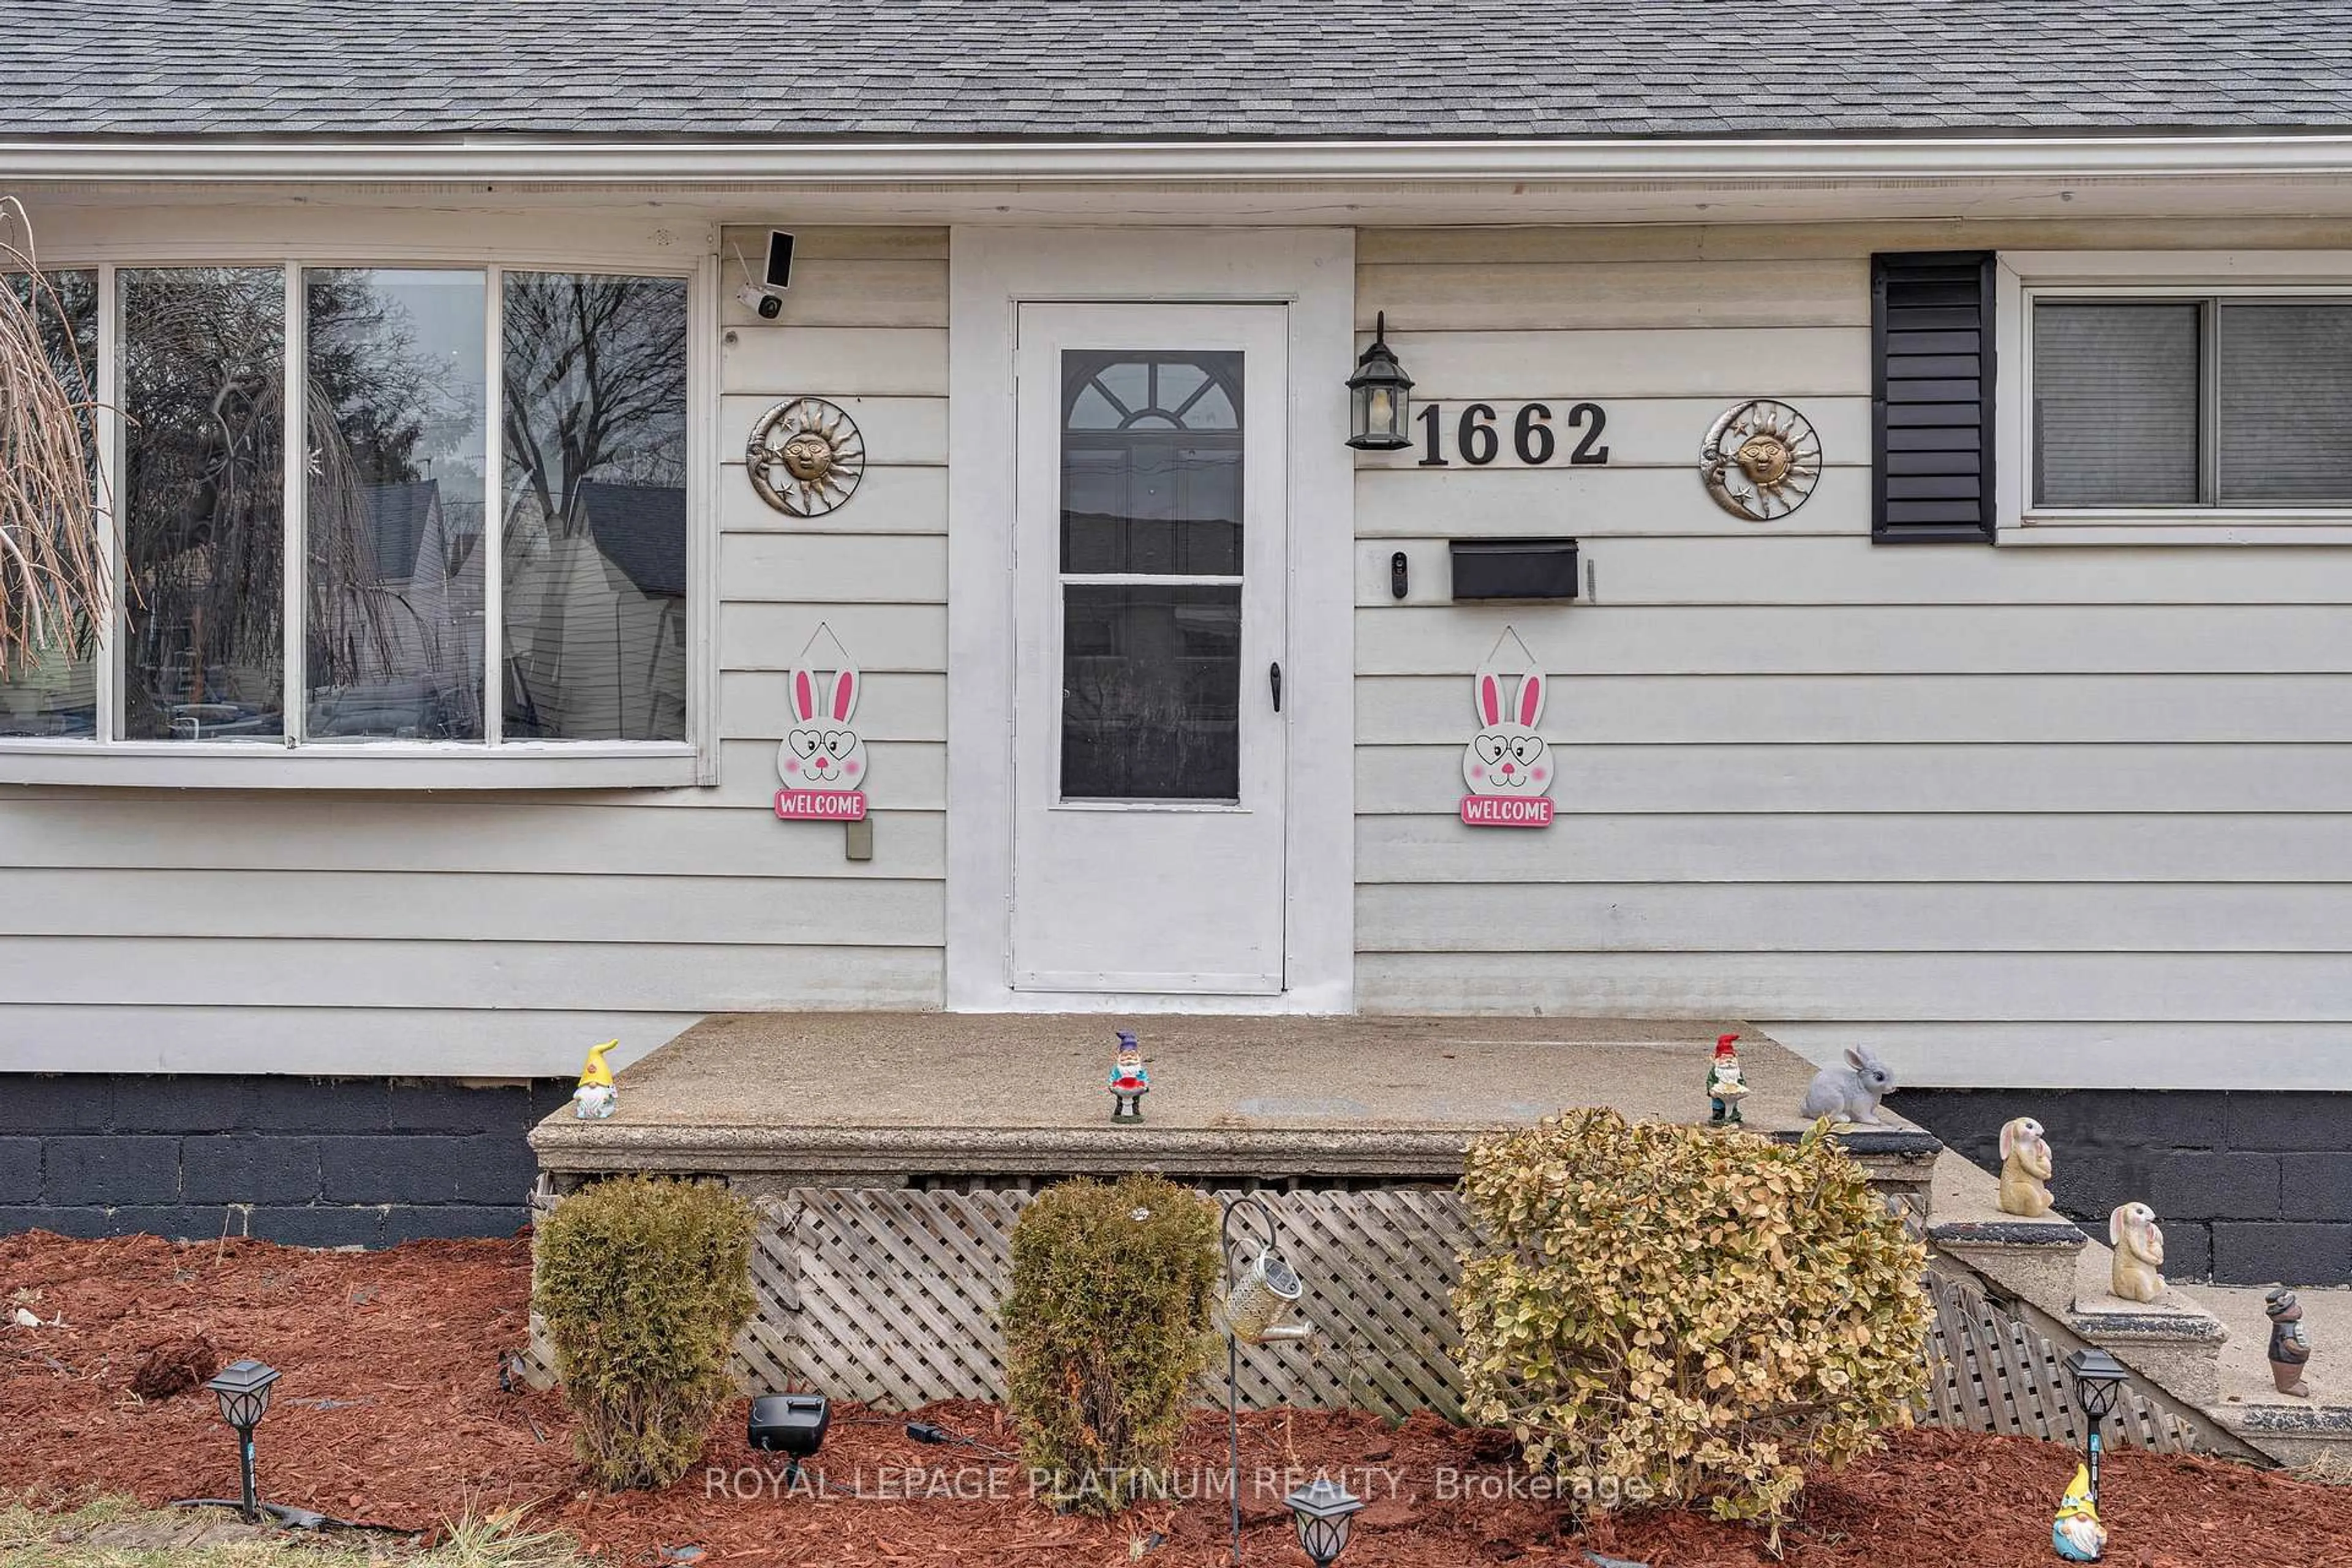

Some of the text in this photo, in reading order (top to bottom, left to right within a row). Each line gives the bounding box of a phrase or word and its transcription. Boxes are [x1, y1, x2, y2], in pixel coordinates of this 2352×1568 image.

[1417, 403, 1608, 466] 1662
[780, 794, 861, 815] WELCOME
[1466, 801, 1548, 821] WELCOME
